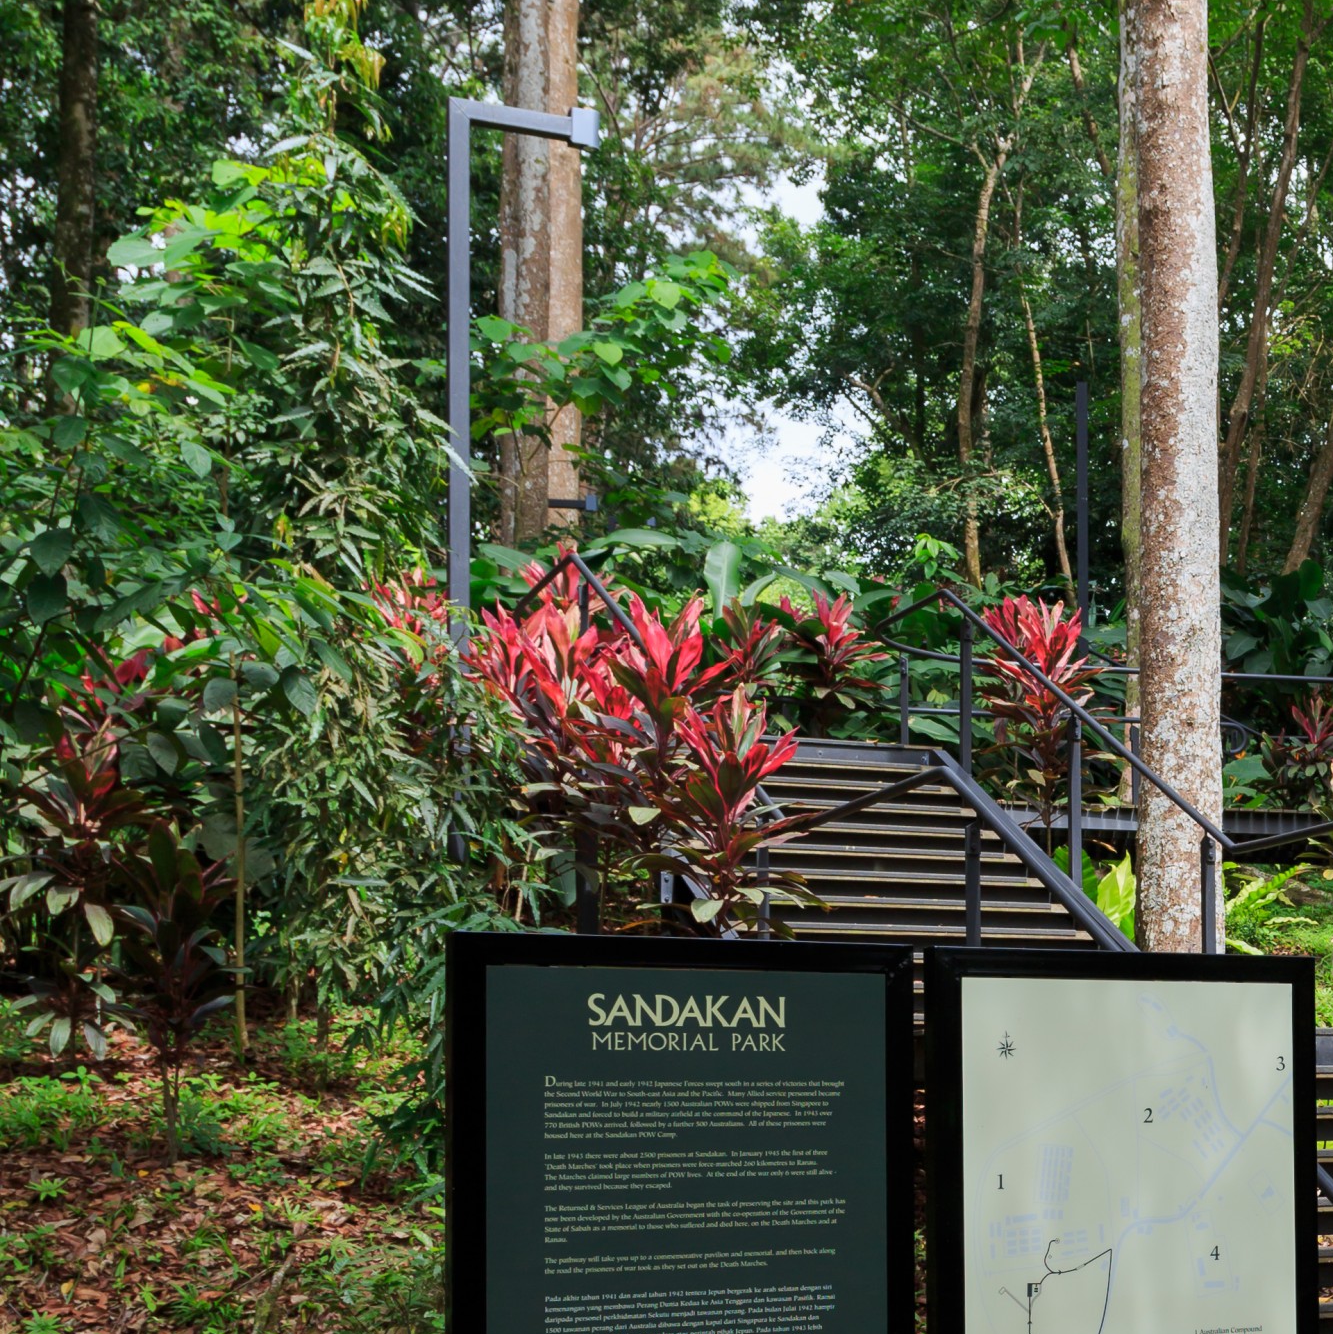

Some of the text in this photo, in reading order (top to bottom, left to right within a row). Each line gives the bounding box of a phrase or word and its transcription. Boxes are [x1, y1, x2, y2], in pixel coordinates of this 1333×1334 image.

[587, 993, 786, 1028] SANDAKAN
[592, 1032, 786, 1052] MEMORIAL PARK
[1276, 1055, 1286, 1072] 3
[1143, 1107, 1154, 1124] 2
[997, 1173, 1005, 1190] 1
[1209, 1245, 1221, 1261] 4
